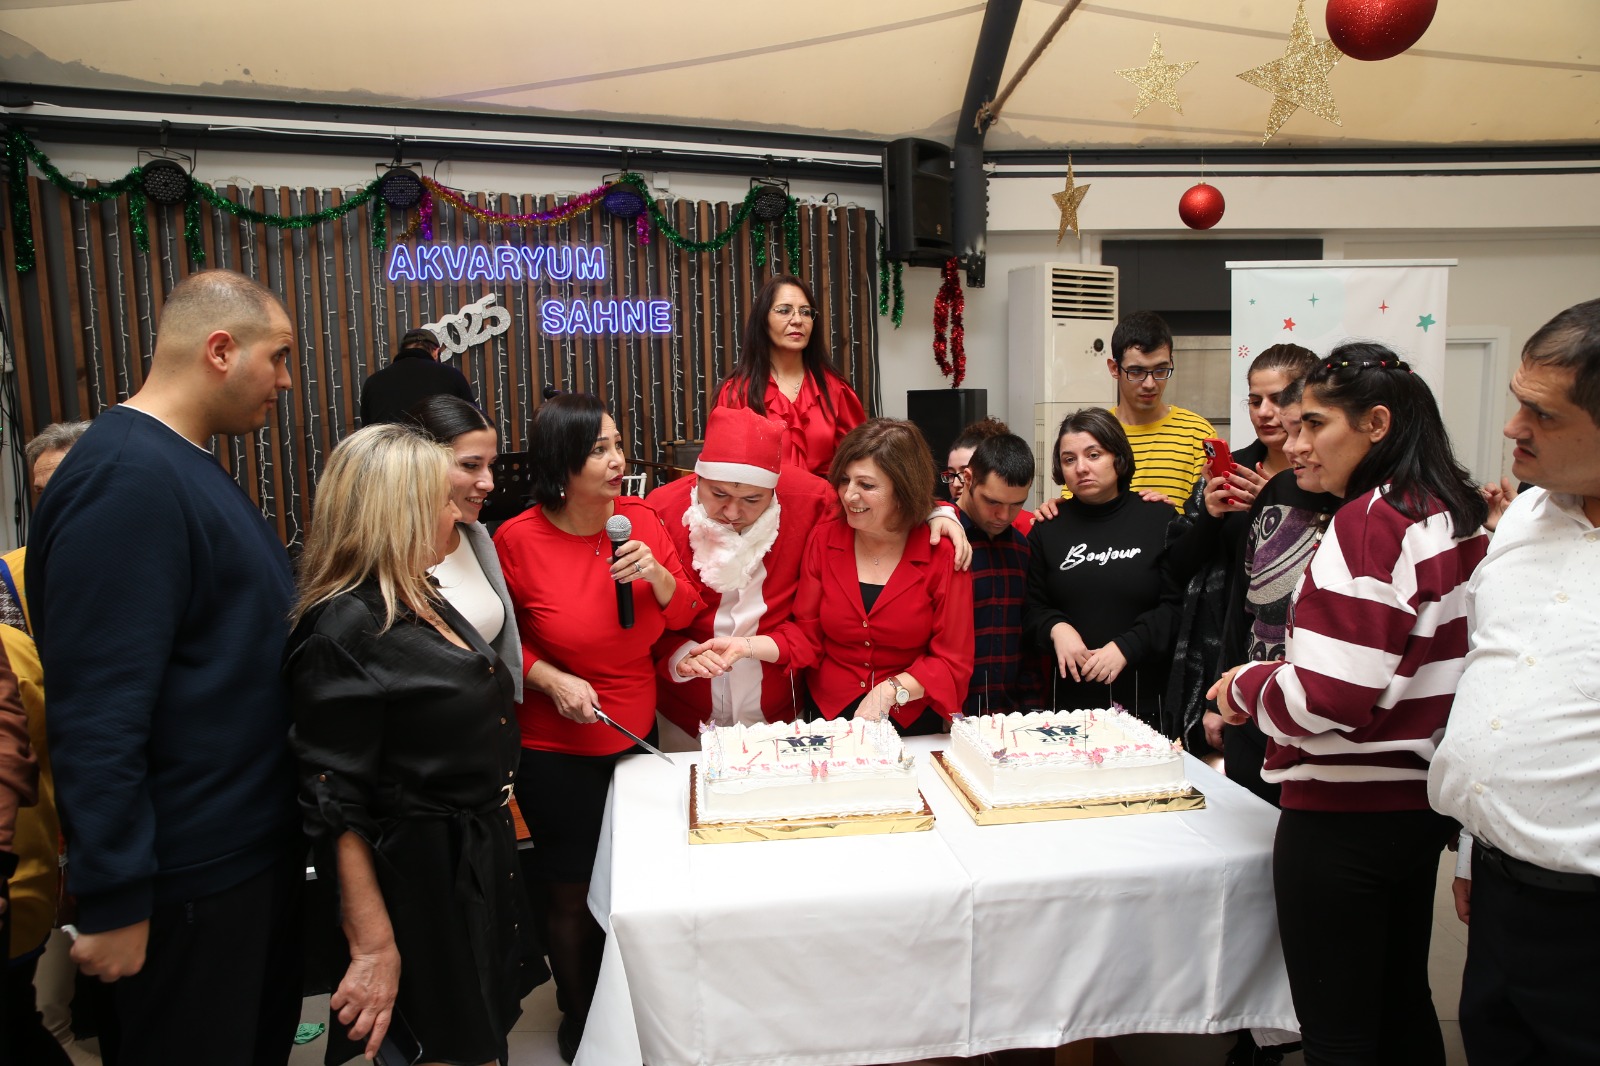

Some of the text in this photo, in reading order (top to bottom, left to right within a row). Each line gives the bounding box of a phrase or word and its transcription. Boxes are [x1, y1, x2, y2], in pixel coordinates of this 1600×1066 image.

[388, 244, 606, 281] AKVARYUM
[541, 299, 672, 335] SAHNE
[1060, 543, 1141, 571] Bonjour
